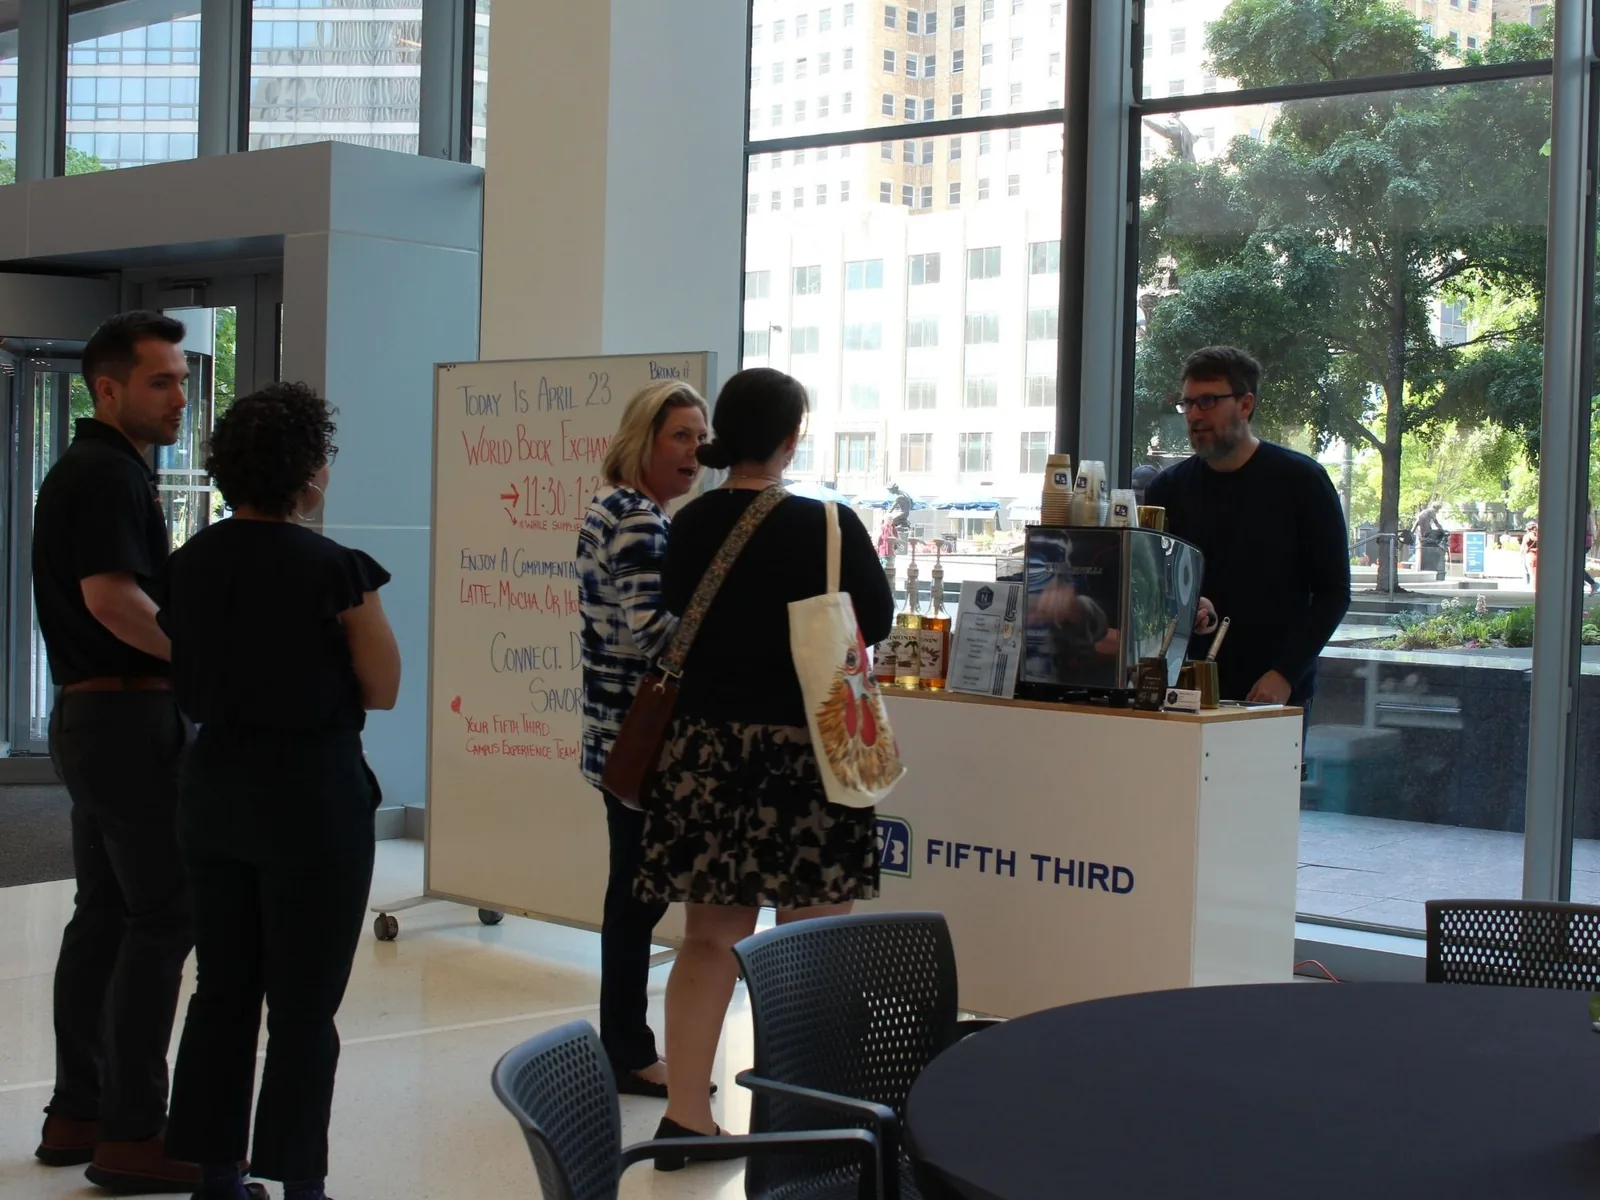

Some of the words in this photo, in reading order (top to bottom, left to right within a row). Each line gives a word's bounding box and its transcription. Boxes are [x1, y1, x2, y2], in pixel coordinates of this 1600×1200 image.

[649, 360, 680, 380] BRING
[457, 385, 502, 417] TODAY
[514, 380, 529, 413] IS
[538, 376, 578, 412] APRIL
[586, 372, 612, 406] 23
[462, 425, 512, 466] WORLD
[517, 424, 554, 466] BOOK
[460, 548, 496, 571] ENJOY
[501, 547, 508, 572] A
[460, 578, 496, 609] LATTE,
[499, 580, 543, 614] MOCHA,
[545, 584, 560, 618] OR
[491, 631, 562, 673] CONNECT.
[465, 716, 488, 734] YOUR
[493, 714, 519, 736] FIFTH
[520, 713, 550, 737] THIRD
[466, 737, 499, 756] CAMPUS
[502, 739, 552, 760] EXPERIENCE
[552, 739, 580, 760] TEAM!
[927, 839, 1016, 877] FIFTH
[1030, 854, 1134, 895] THIRD
